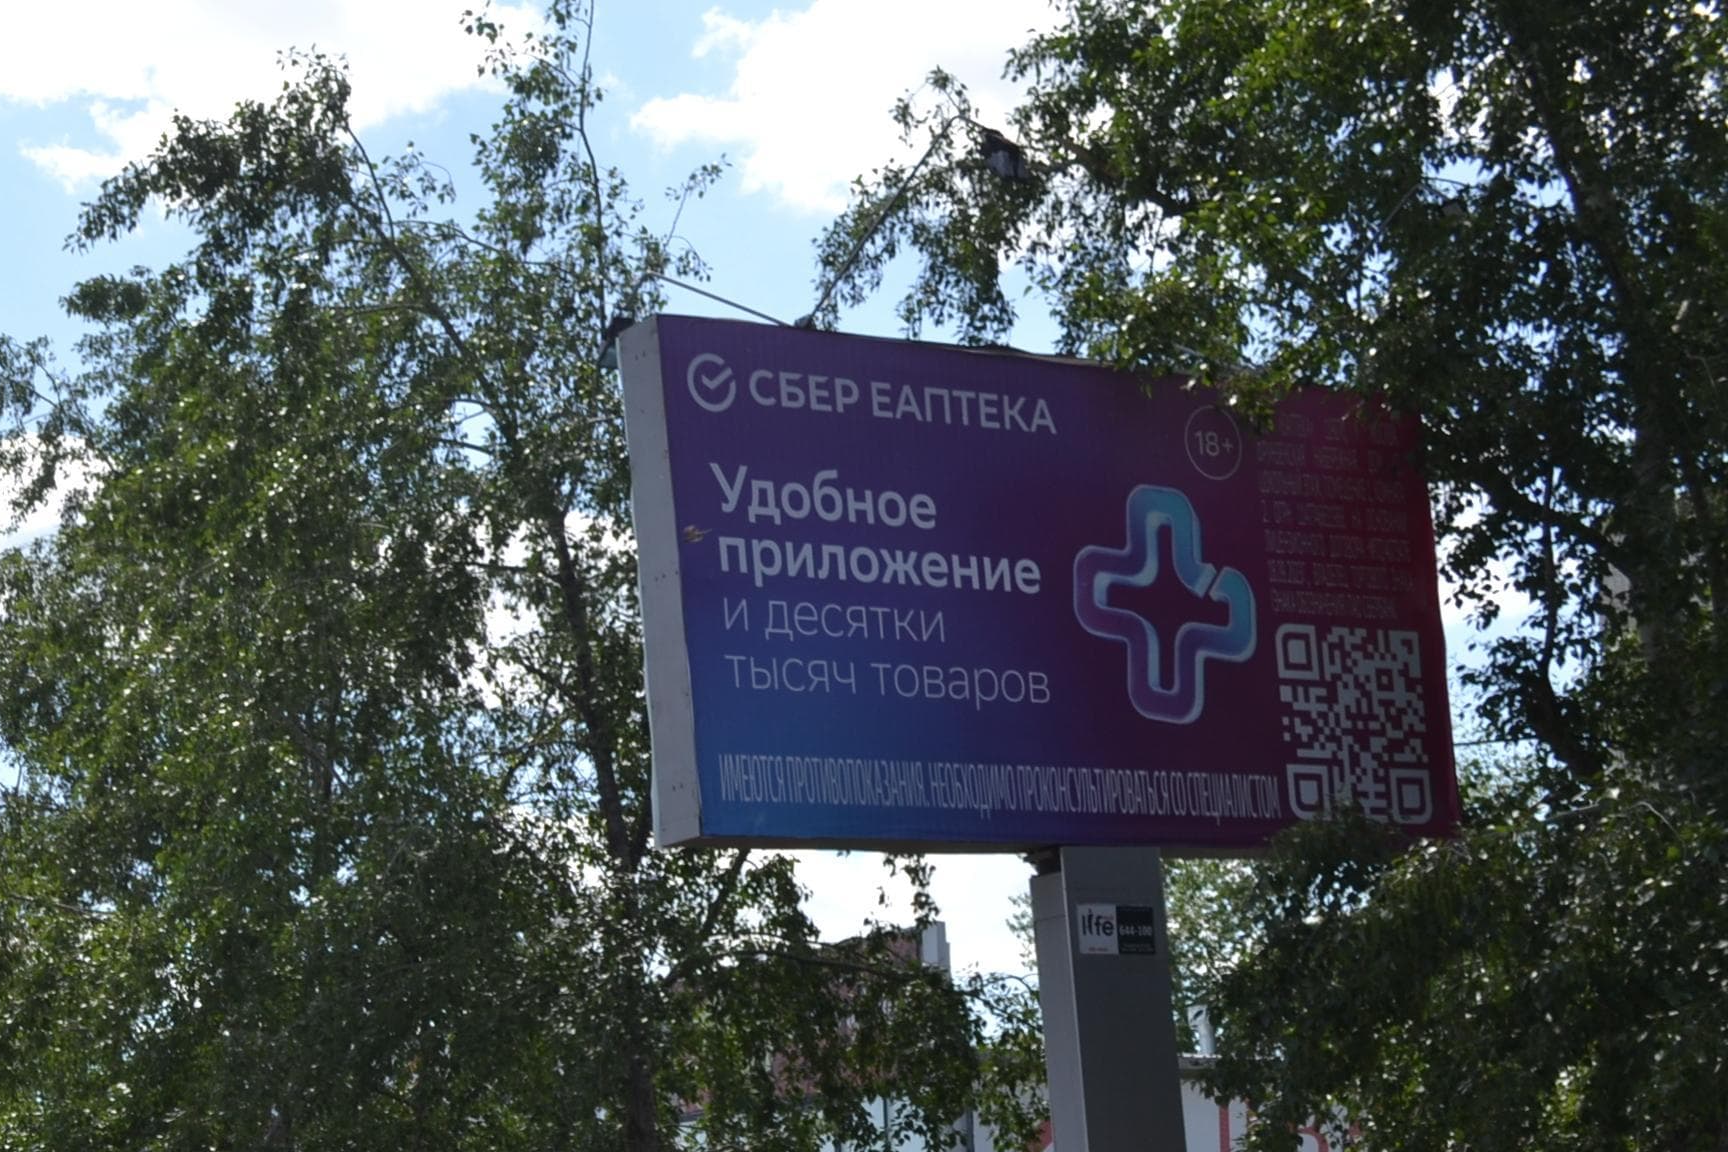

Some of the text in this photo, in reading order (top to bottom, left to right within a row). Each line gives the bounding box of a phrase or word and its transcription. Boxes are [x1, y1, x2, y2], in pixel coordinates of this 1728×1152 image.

[748, 368, 1058, 435] СБЕР ЕАПТЕКА
[1193, 429, 1234, 457] 18+
[709, 462, 937, 530] Удобное
[717, 535, 1042, 595] приложение
[723, 596, 946, 643] и десятки
[723, 653, 1051, 711] тысяч товаров
[718, 753, 785, 804] ИМЕЮТСЯ
[929, 761, 1016, 821] НЕОБХОДИМО
[1016, 765, 1170, 817] ПРОКОНСУЛЬТИРОВАТЬСЯ
[1170, 770, 1187, 816] СО
